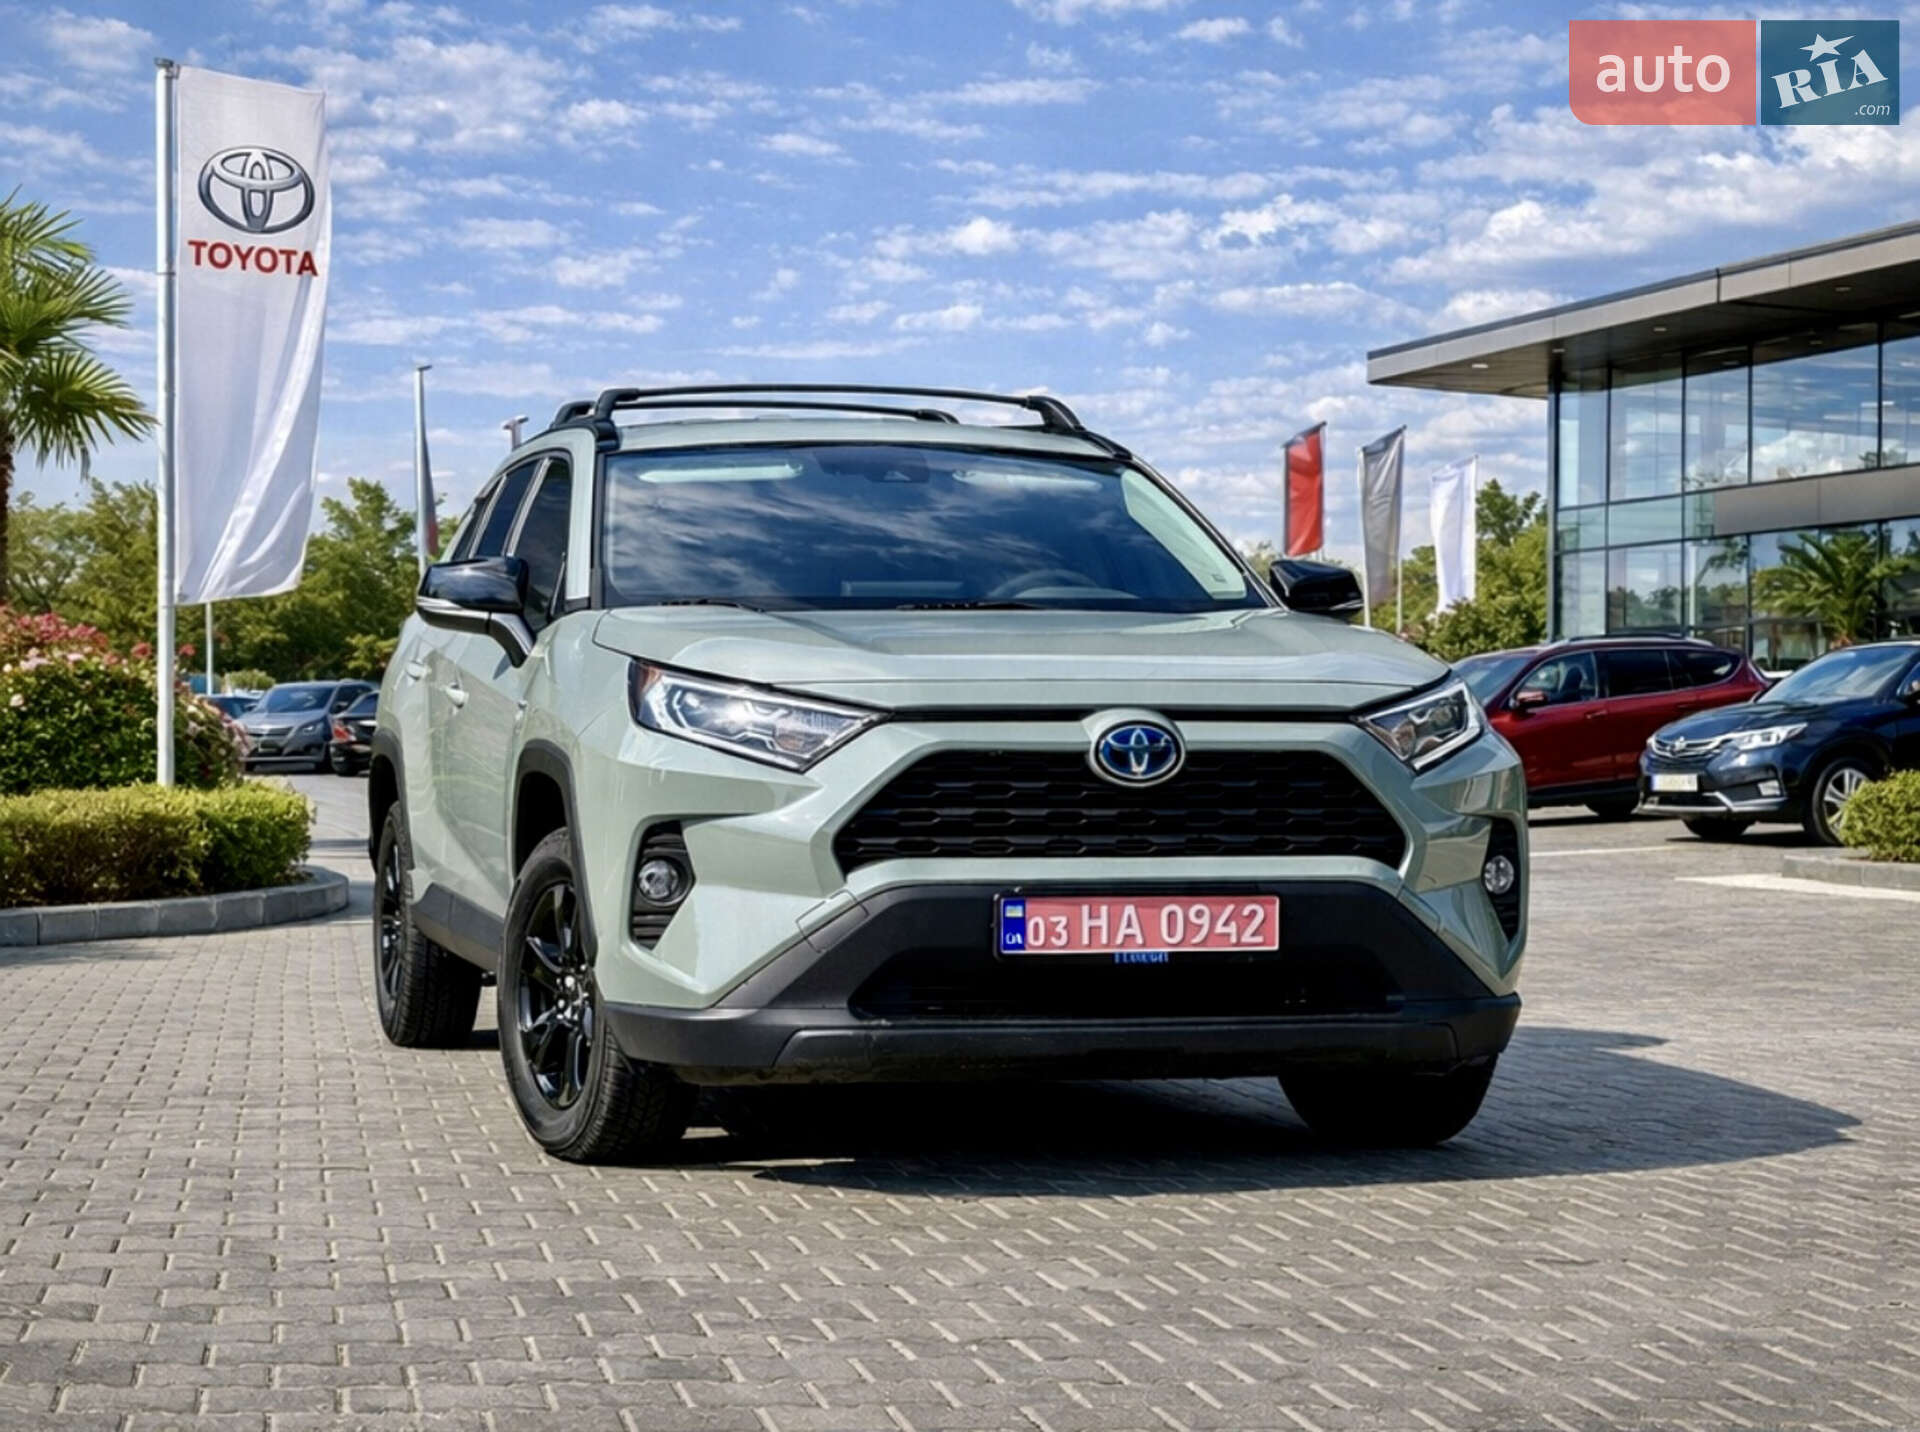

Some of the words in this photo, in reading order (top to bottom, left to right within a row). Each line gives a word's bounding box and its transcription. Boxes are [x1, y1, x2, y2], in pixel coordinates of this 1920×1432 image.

[187, 240, 319, 277] TOYOTA
[1027, 916, 1069, 947] 03
[1081, 904, 1145, 945] HA
[1160, 903, 1265, 945] 0942
